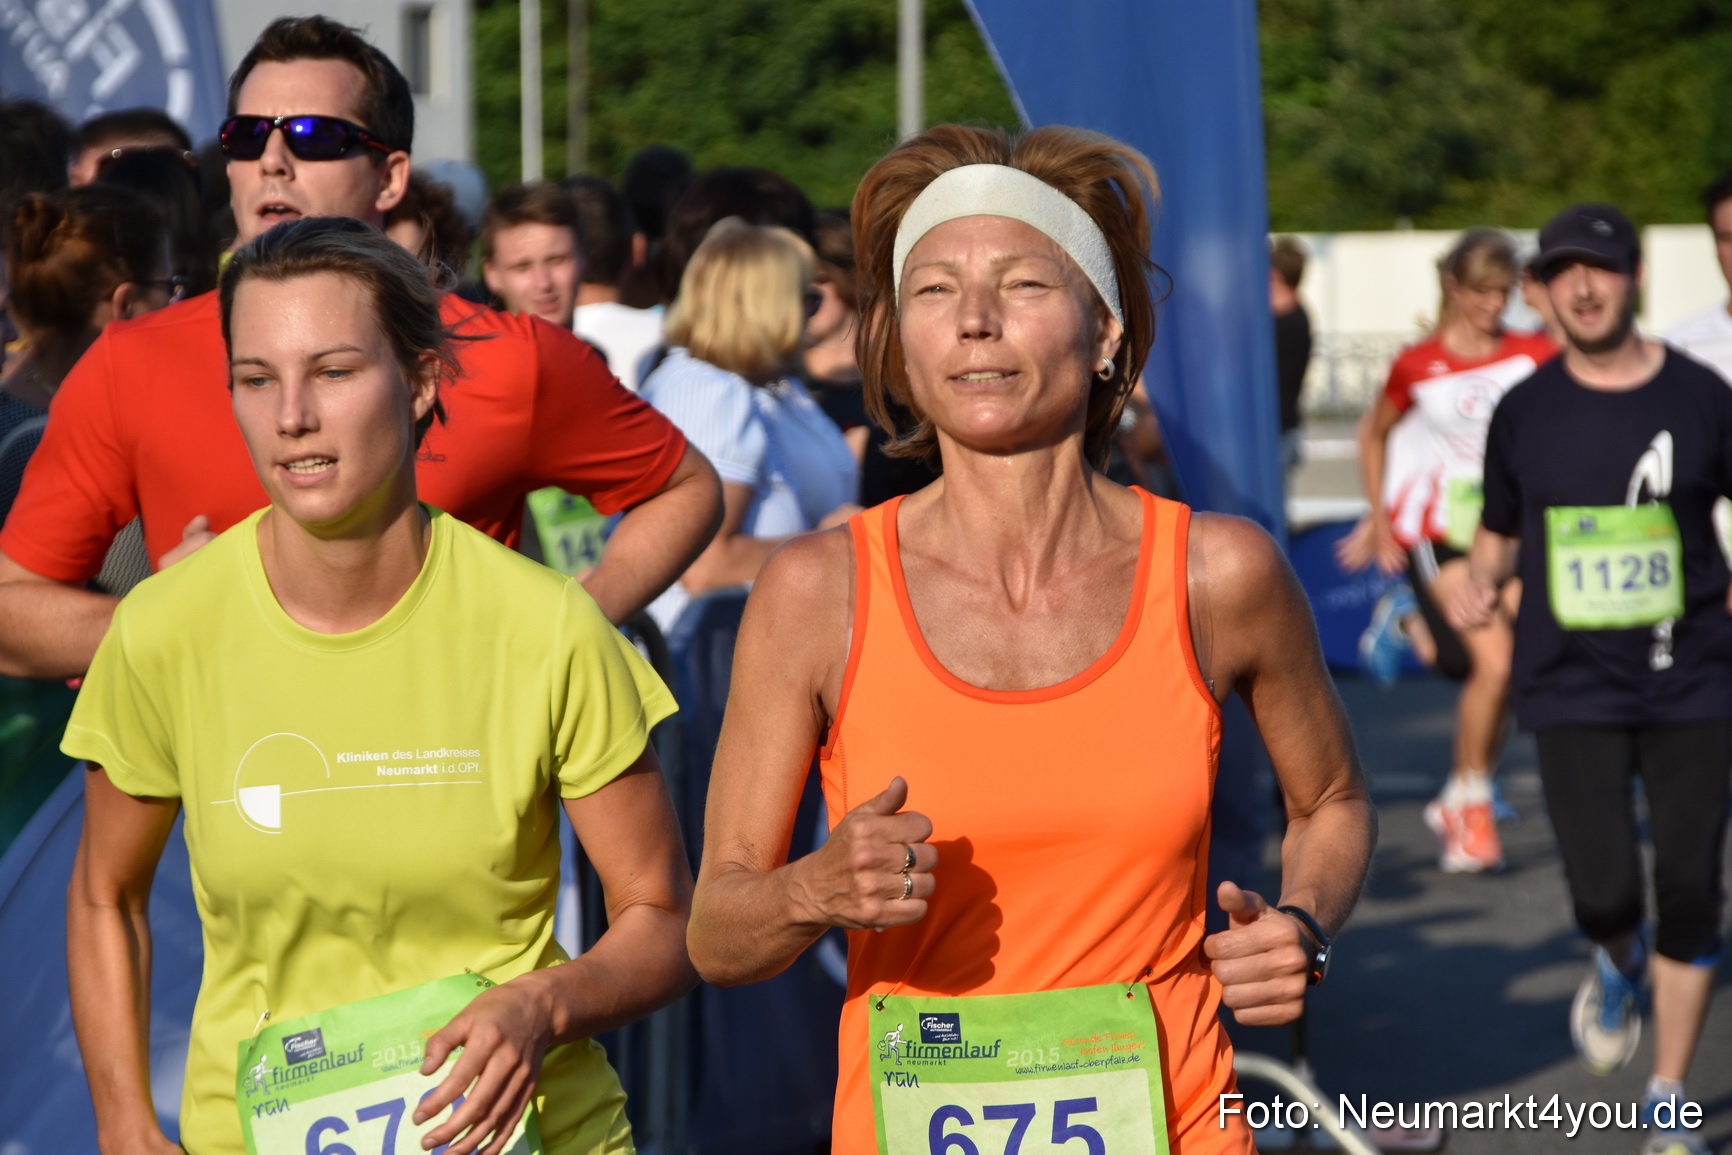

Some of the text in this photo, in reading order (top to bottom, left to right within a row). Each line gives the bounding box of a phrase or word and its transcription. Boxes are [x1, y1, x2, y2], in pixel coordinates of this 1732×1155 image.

[557, 532, 605, 570] 14
[1566, 551, 1671, 593] 1128
[336, 747, 481, 764] Kliniken des Landkreises
[376, 762, 482, 777] Neumarkt i.d.OPf.
[926, 1020, 955, 1030] Fischer
[1105, 1031, 1137, 1042] Firmen
[272, 1043, 364, 1085] firmenlauf
[371, 1039, 421, 1069] 2015
[905, 1039, 1060, 1068] firmenlauf 2015
[1015, 1053, 1141, 1075] www.firmenlauf-oberpfalz.de
[305, 1086, 478, 1155] 67
[928, 1096, 1106, 1155] 675
